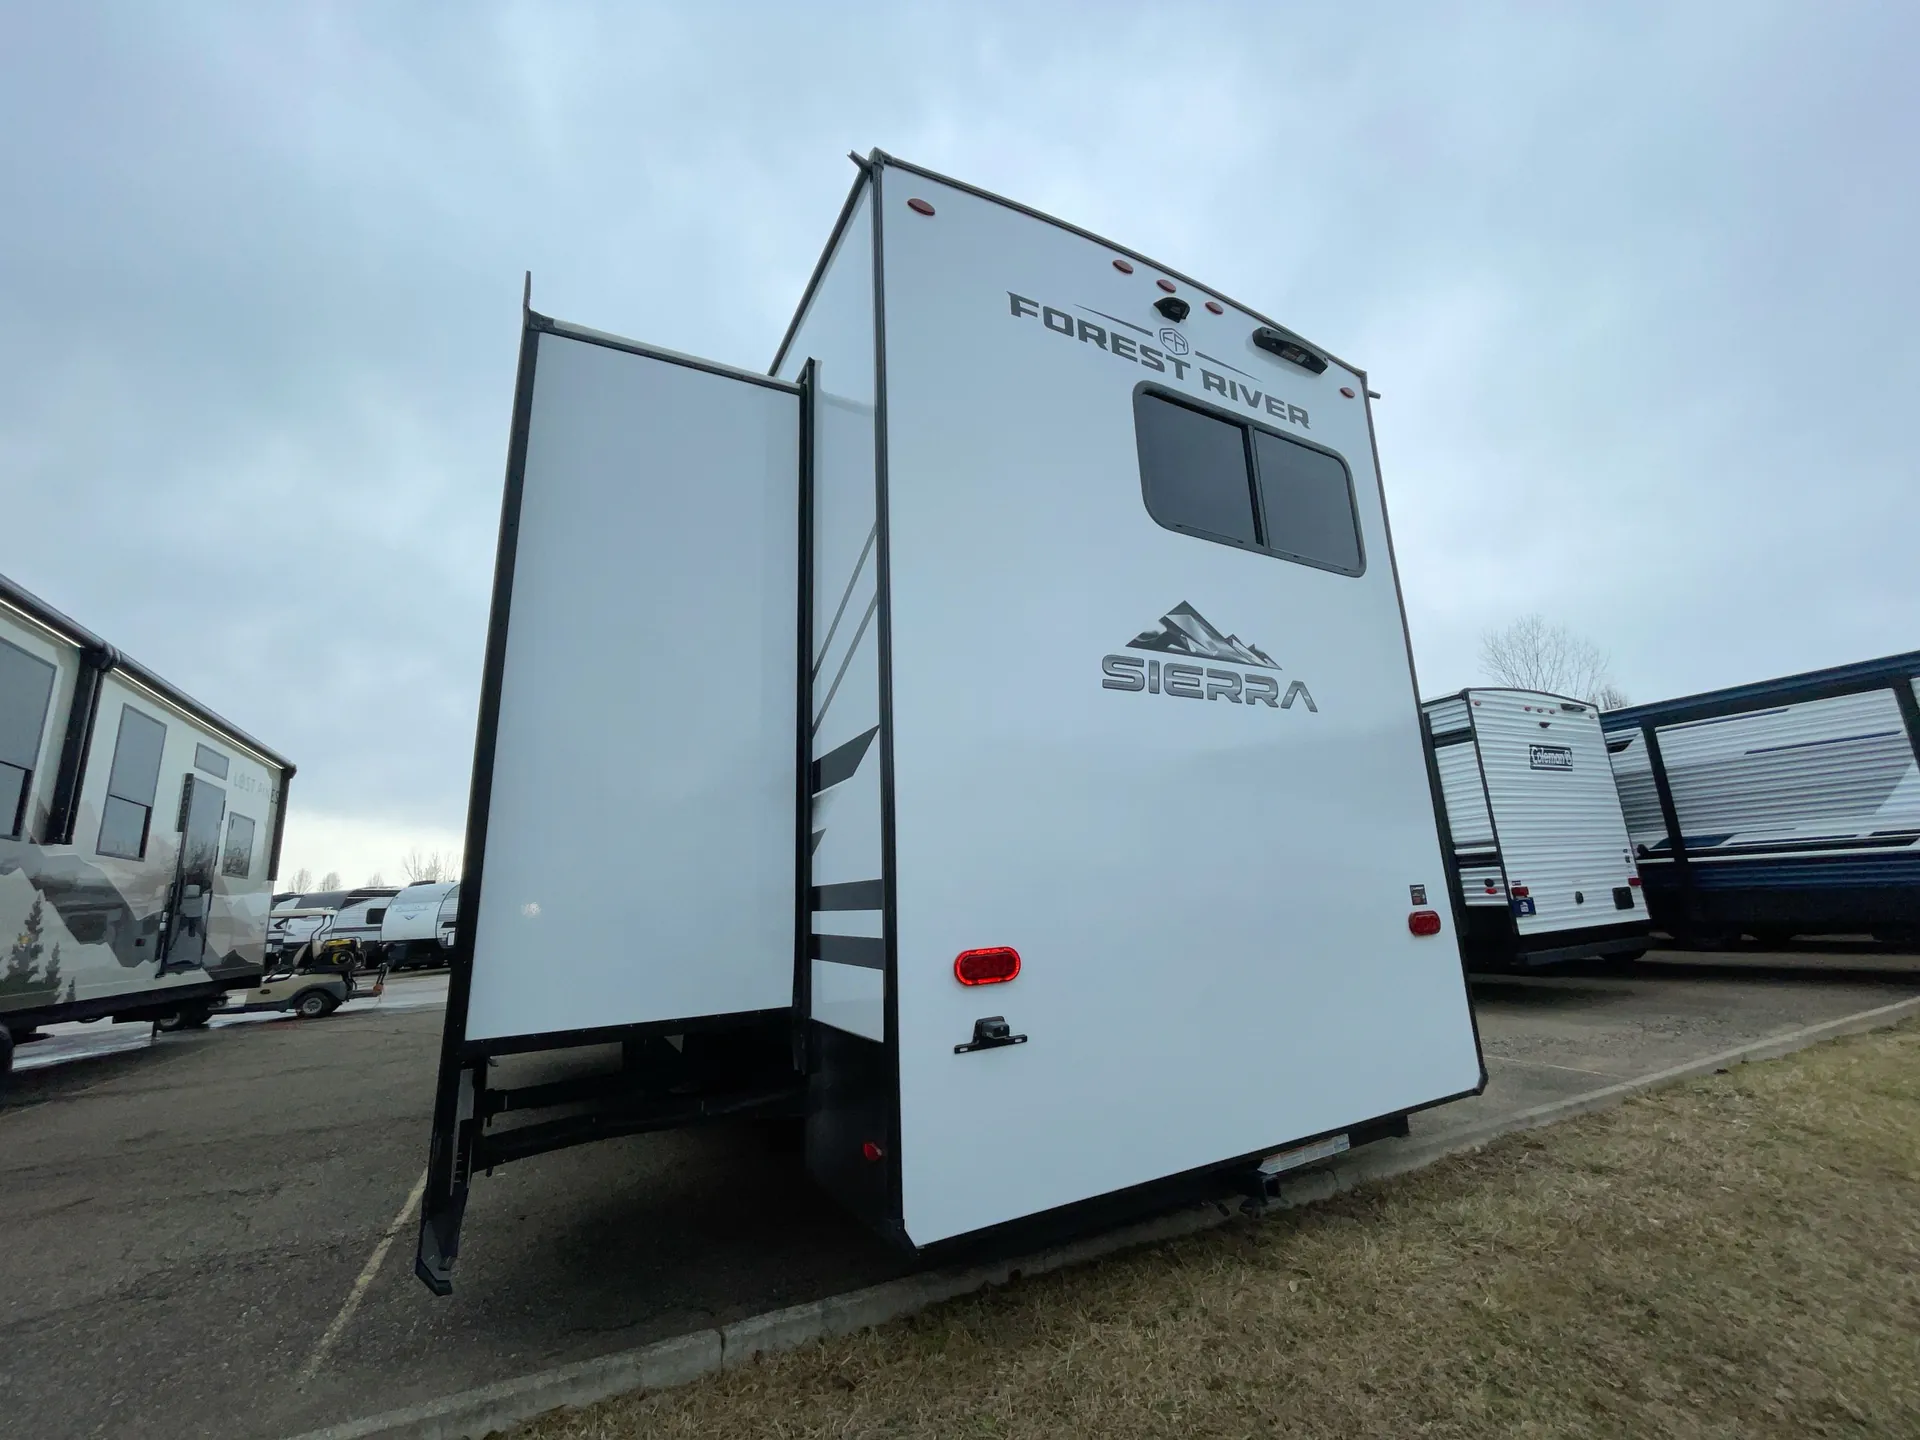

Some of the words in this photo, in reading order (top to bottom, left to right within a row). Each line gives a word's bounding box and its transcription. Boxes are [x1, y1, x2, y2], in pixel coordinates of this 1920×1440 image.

[1006, 291, 1191, 381] FOREST
[1199, 367, 1311, 430] RIVER
[1101, 654, 1318, 713] SIERRA
